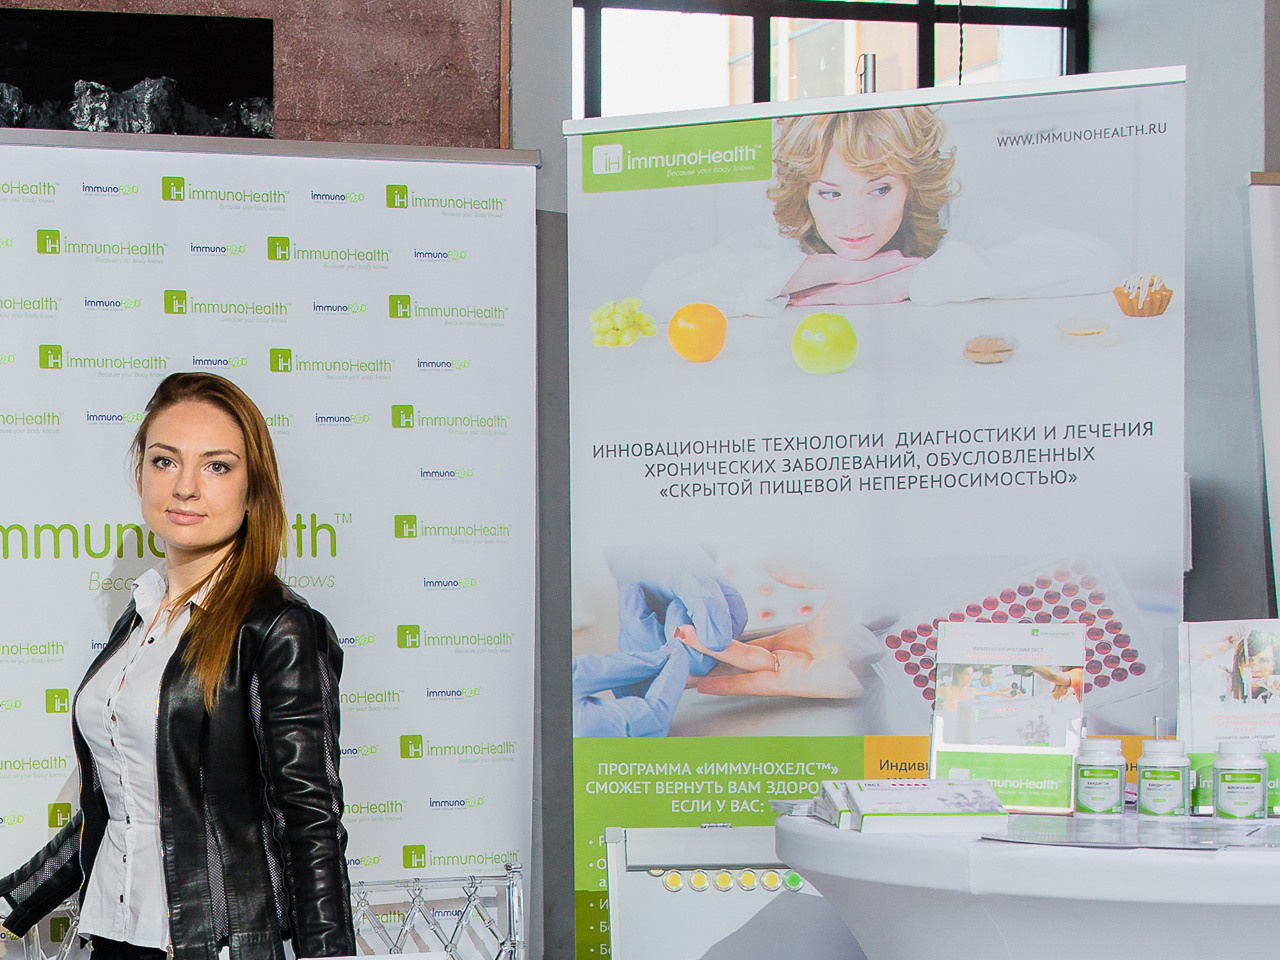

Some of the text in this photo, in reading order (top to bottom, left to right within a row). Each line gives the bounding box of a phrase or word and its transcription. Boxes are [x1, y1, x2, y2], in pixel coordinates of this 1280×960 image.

[997, 122, 1167, 147] WWW.IMMUNOHEALTH.RU
[627, 146, 755, 170] immunoHealth
[593, 422, 1153, 459] ИННОВАЦИОННЫЕ ТЕХНОЛОГИИ ДИАГНОСТИКИ И ЛЕЧЕНИЯ
[644, 446, 1095, 478] ХРОНИЧЕСКИХ ЗАБОЛЕВАНИЙ, ОБУСЛОВЛЕННЫХ
[659, 469, 1078, 498] «СКРЫТОЙ ПИЩЕВОЙ НЕПЕРЕНОСИМОСТЬЮ»
[598, 762, 691, 776] ПРОГРАММА
[586, 781, 818, 795] СМОЖЕТ ВЕРНУТЬ ВАМ ЗДОРО
[671, 799, 764, 813] ЕСЛИ У ВАС:
